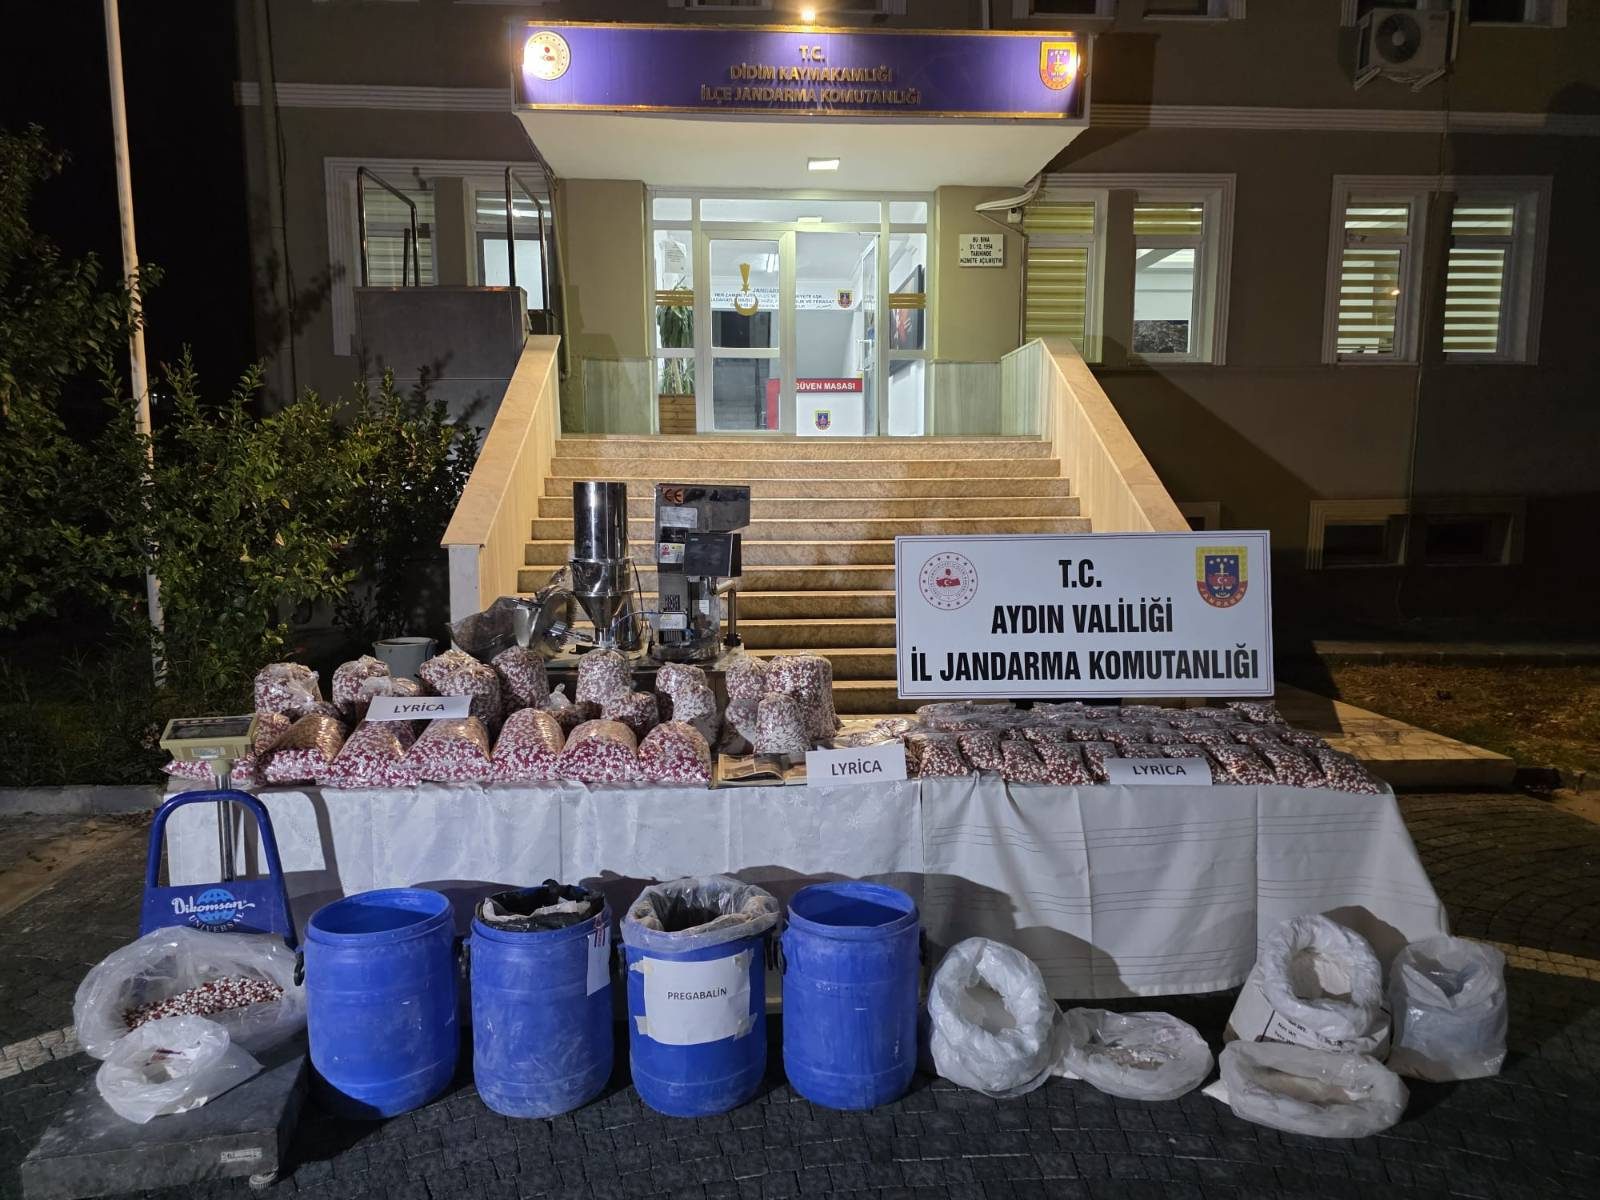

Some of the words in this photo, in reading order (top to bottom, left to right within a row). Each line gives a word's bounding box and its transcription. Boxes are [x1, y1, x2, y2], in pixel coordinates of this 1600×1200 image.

[799, 45, 826, 62] T.C.
[730, 62, 776, 81] DİDİM
[778, 64, 894, 82] KAYMAKAMLIĞI
[700, 84, 732, 104] İLÇE
[734, 87, 816, 103] JANDARMA
[819, 85, 922, 105] KOMUTANLIĞI
[823, 382, 856, 390] MASASI
[1058, 559, 1102, 588] T.C.
[991, 604, 1065, 634] AYDIN
[1072, 597, 1173, 633] VALİLİĞİ
[910, 646, 932, 682] İL
[939, 650, 1081, 681] JANDARMA
[1089, 643, 1259, 680] KOMUTANLIĞI
[393, 702, 445, 714] LYRİCA
[831, 758, 882, 776] LYRİCA
[1132, 763, 1187, 776] LYRİCA
[667, 986, 728, 1000] PREGABALİN
